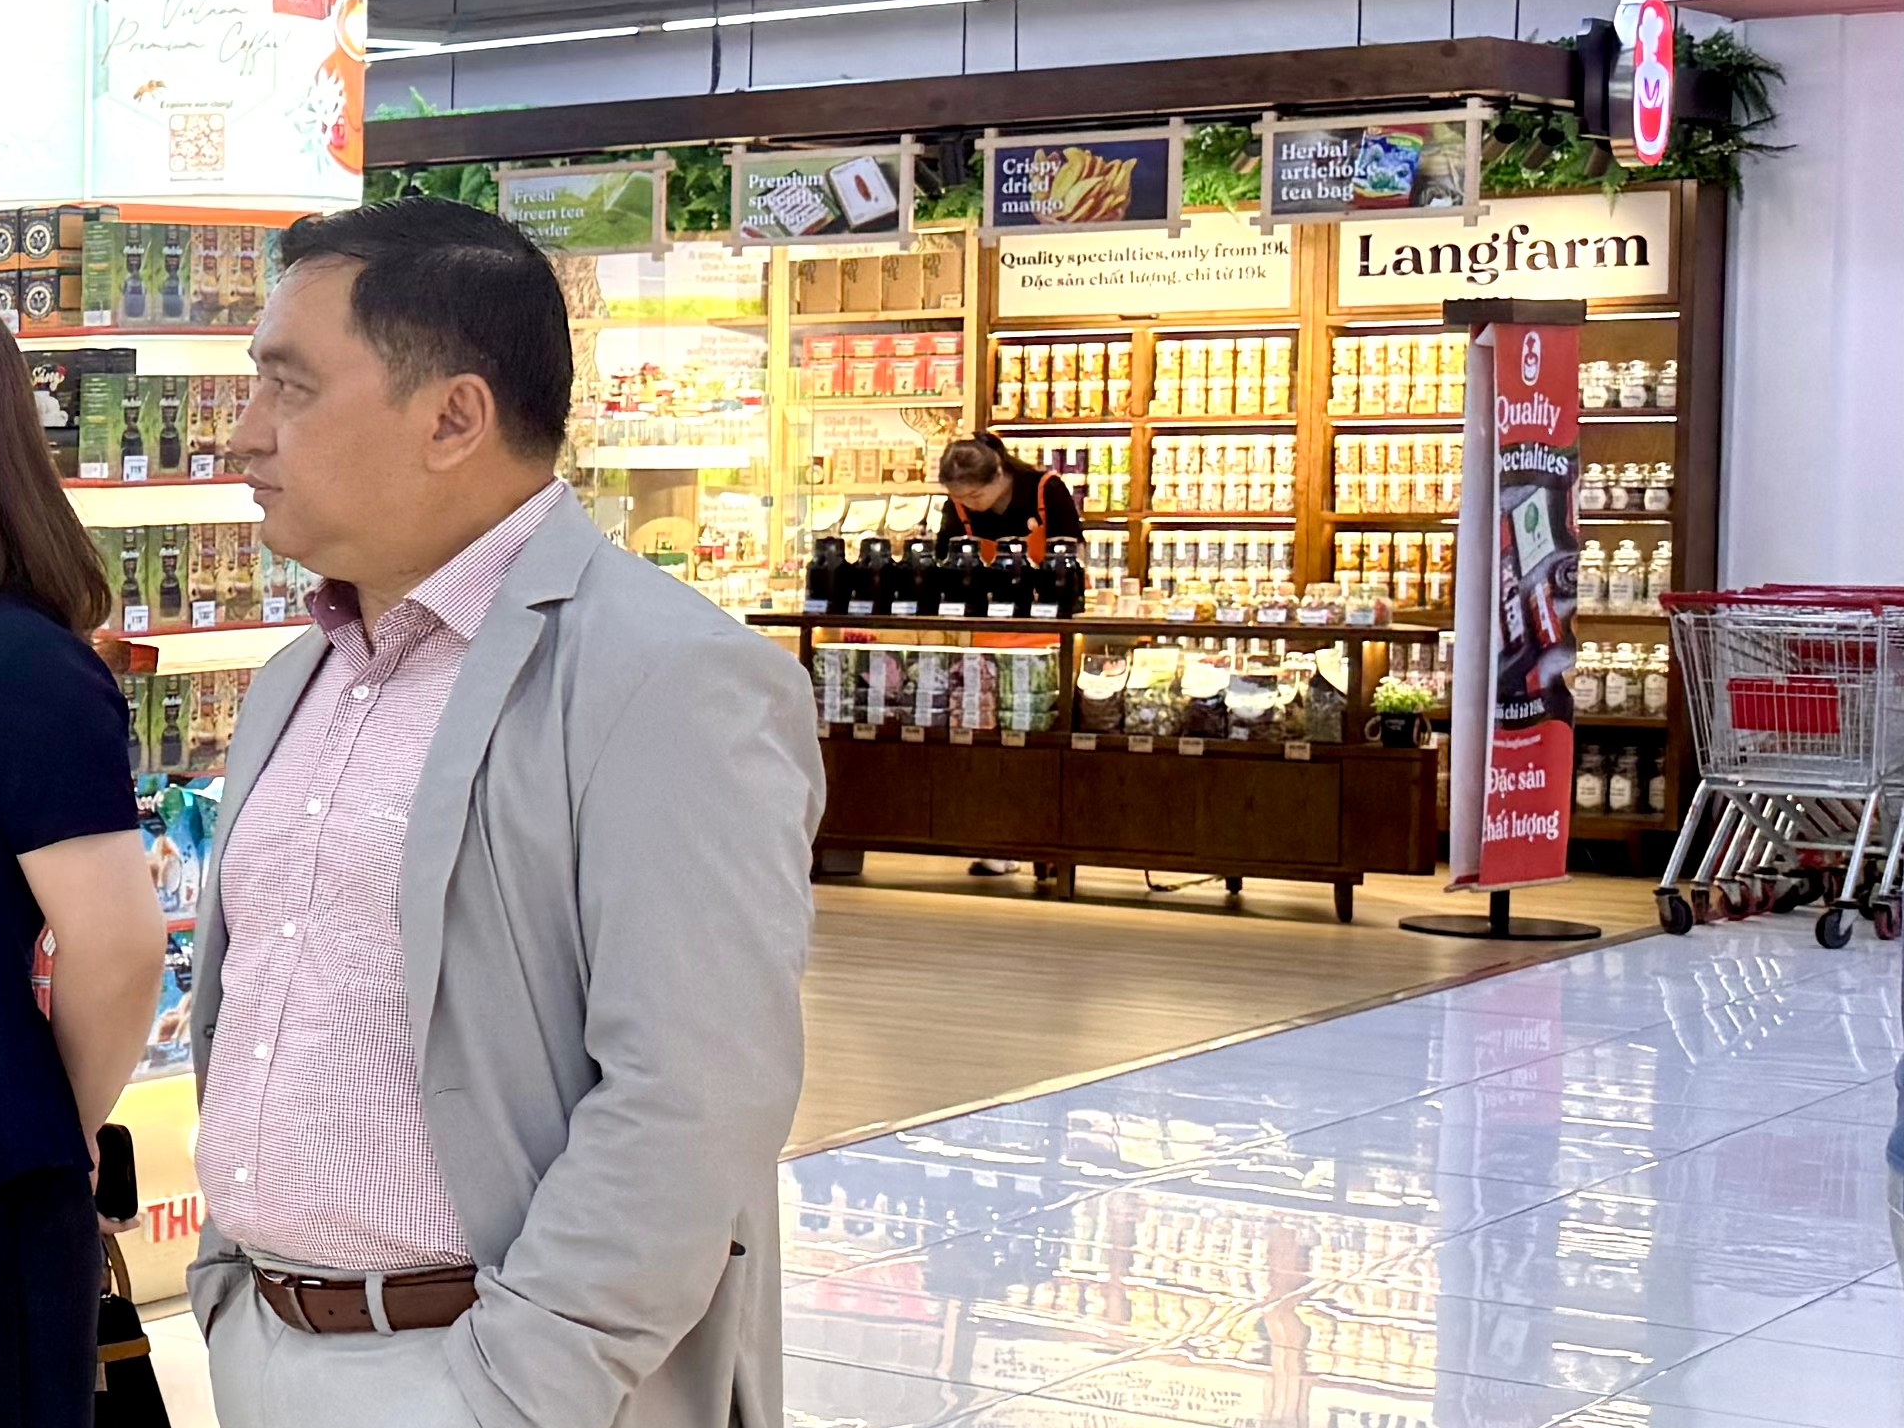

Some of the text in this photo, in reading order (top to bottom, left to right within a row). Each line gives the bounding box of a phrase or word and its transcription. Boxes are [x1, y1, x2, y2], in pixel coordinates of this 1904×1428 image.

[1281, 140, 1348, 161] Herbal
[1002, 158, 1063, 178] Crispy
[748, 172, 824, 191] Premium
[1002, 176, 1050, 194] dried
[1280, 182, 1355, 204] tea bag
[1002, 199, 1064, 217] mango
[1001, 252, 1063, 269] Quality
[1171, 244, 1210, 262] only
[1214, 242, 1257, 258] from
[1261, 240, 1289, 256] 19k
[1358, 224, 1649, 285] Langfarm
[1021, 273, 1053, 292] Đặc
[1239, 266, 1267, 280] 19k
[1496, 392, 1561, 435] Quality
[1518, 763, 1546, 791] sản
[1511, 809, 1560, 844] lượng
